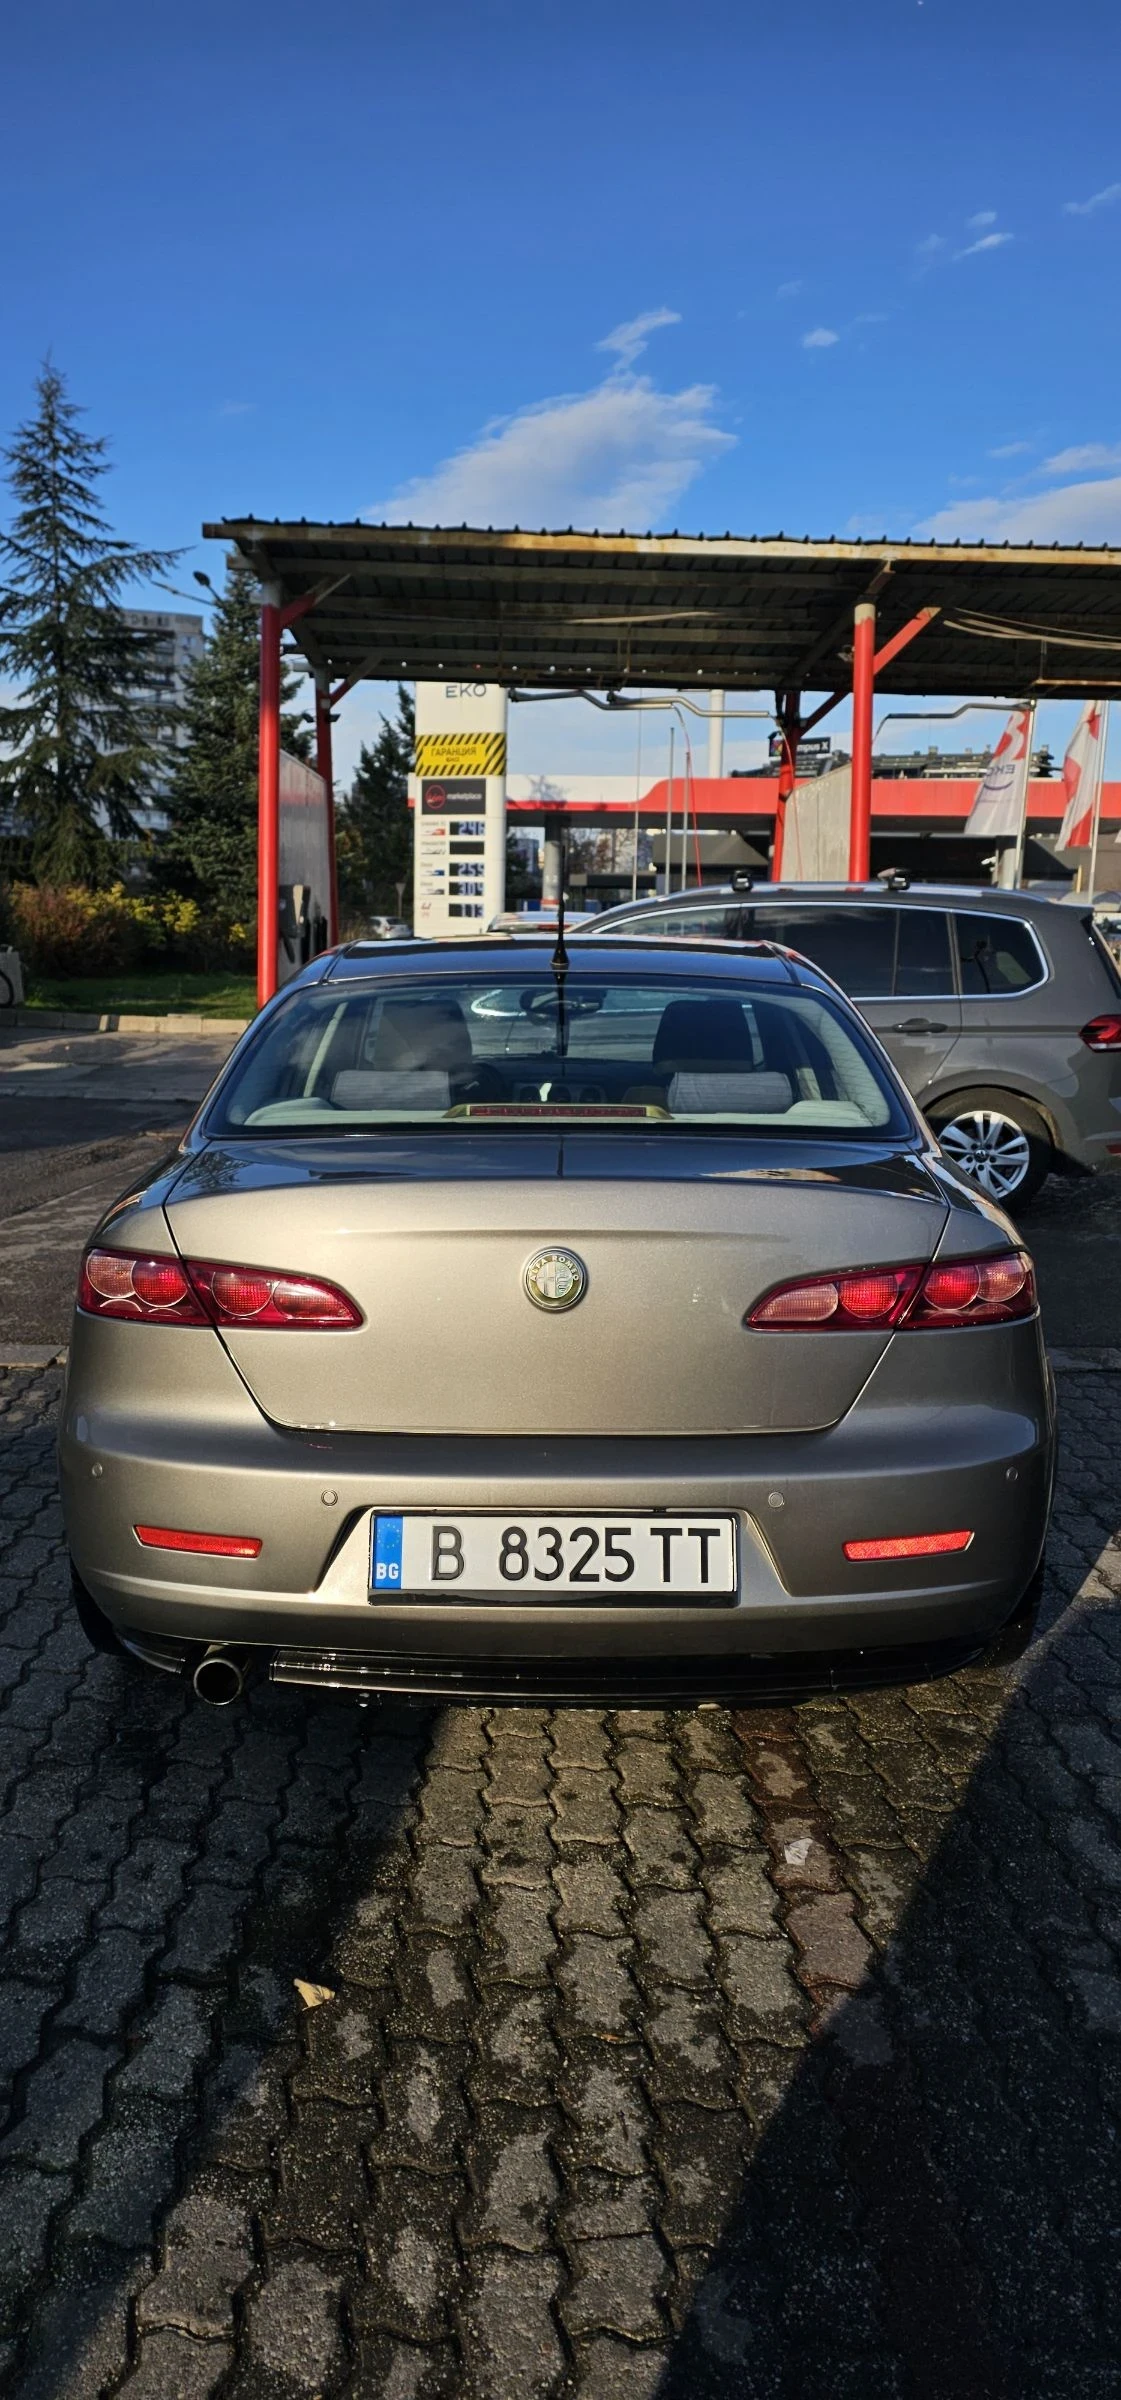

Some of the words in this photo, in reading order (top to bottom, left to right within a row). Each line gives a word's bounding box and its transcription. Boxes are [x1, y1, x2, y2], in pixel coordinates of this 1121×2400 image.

[446, 683, 487, 698] EKO
[430, 747, 477, 756] ГАРАНЦИЯ
[796, 743, 820, 752] mpus
[821, 741, 829, 750] X
[551, 1255, 580, 1281] ROMEO
[431, 1525, 465, 1581] B
[499, 1526, 635, 1583] 8325
[650, 1527, 721, 1583] TT
[375, 1562, 399, 1580] BG
